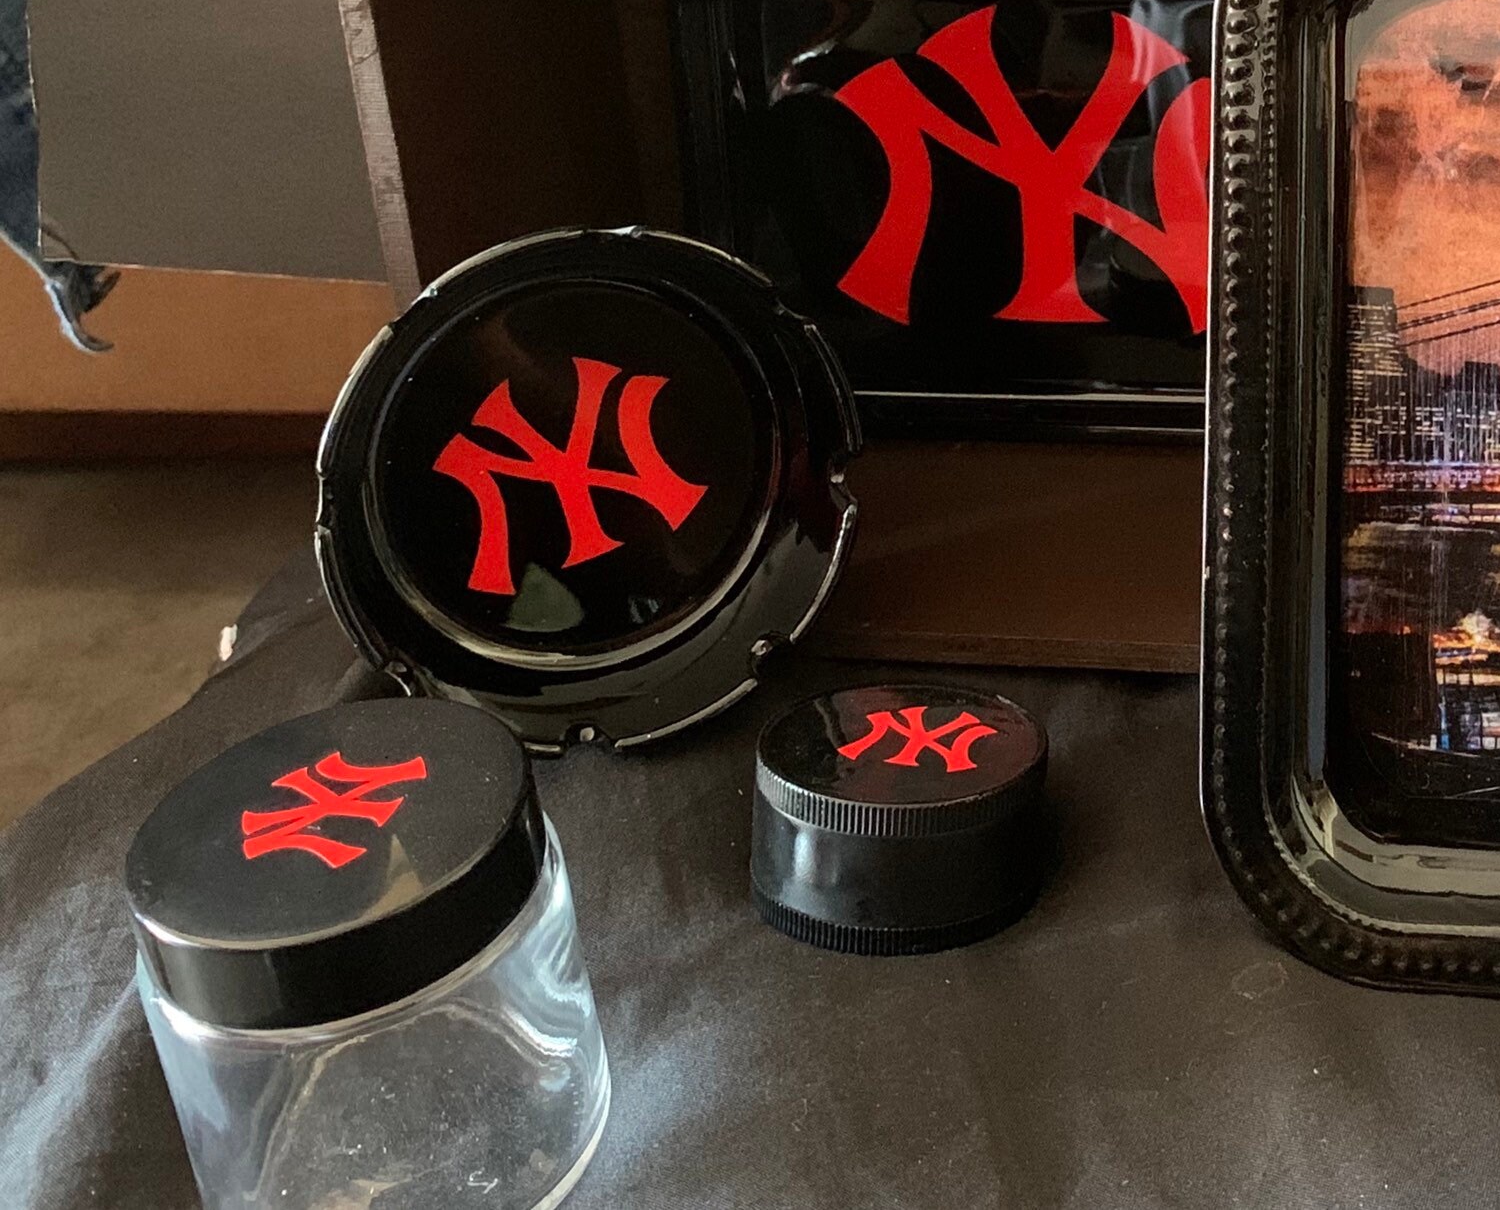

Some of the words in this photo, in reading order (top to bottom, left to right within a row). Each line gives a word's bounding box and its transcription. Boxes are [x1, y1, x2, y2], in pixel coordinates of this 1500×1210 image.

[432, 356, 709, 596] NY
[837, 704, 998, 773] NY
[240, 750, 428, 869] NY
